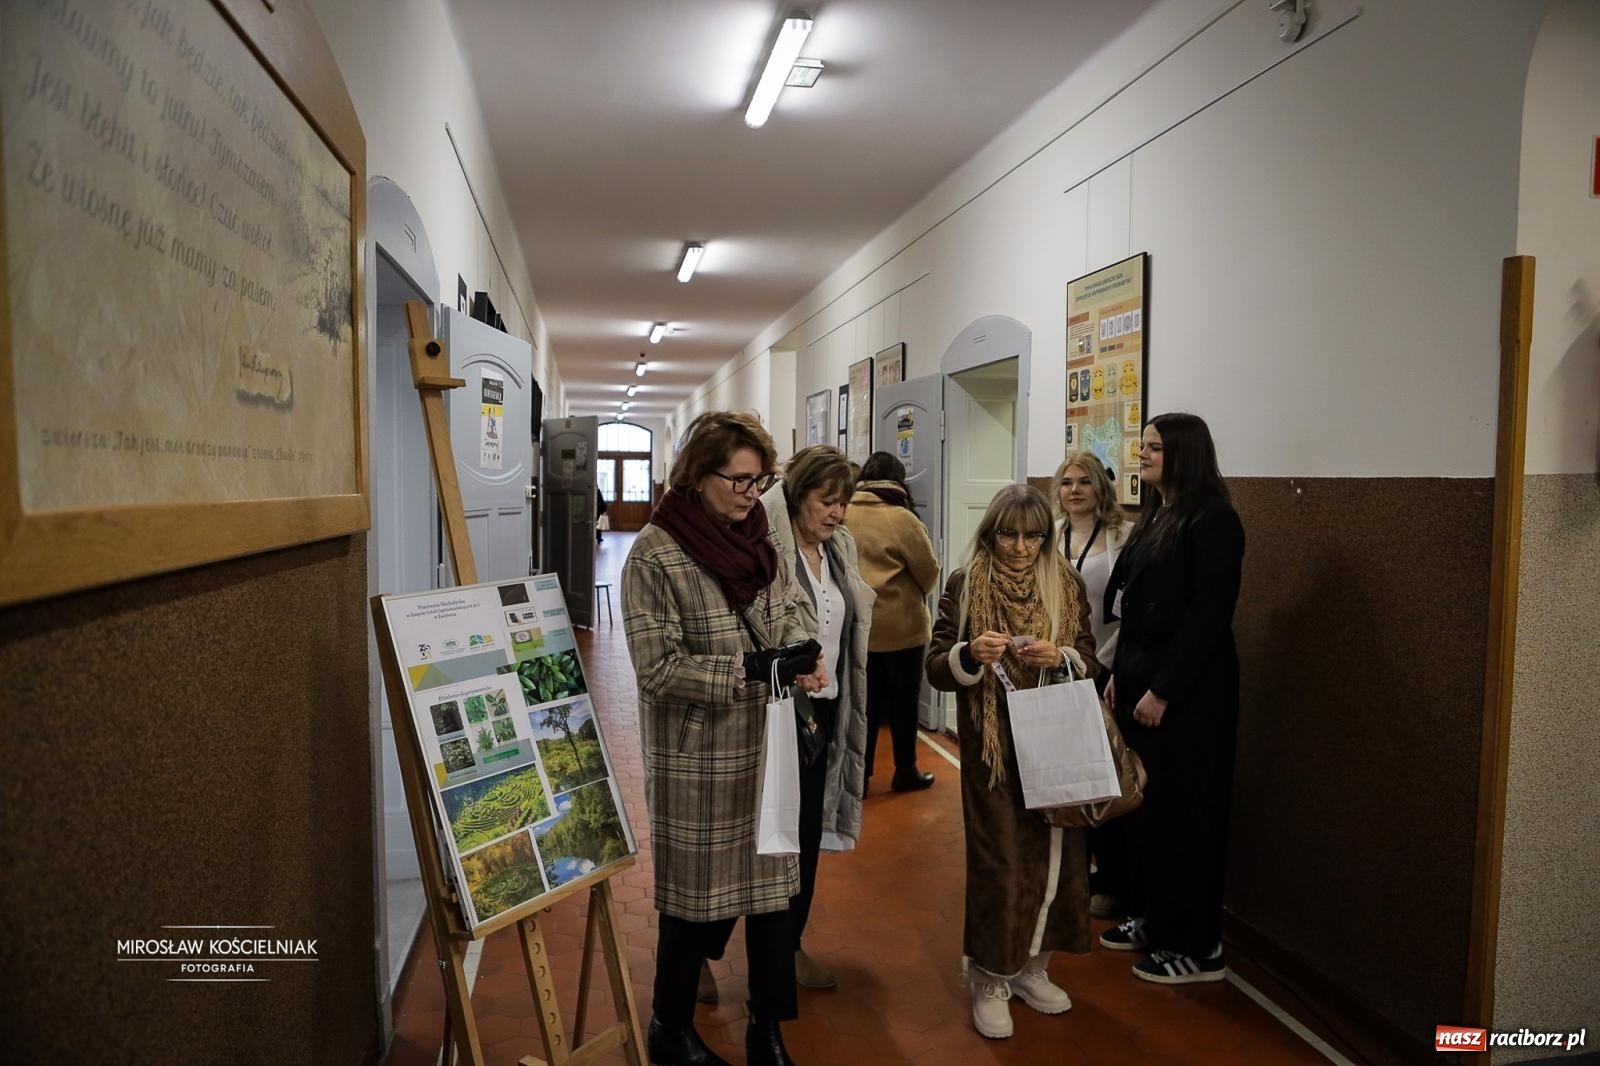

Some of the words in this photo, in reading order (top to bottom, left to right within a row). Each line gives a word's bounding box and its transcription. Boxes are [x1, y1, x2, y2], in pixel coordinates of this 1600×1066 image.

[62, 172, 131, 240] wiosnę
[134, 214, 168, 255] już
[170, 235, 216, 288] mamy
[221, 265, 238, 291] za
